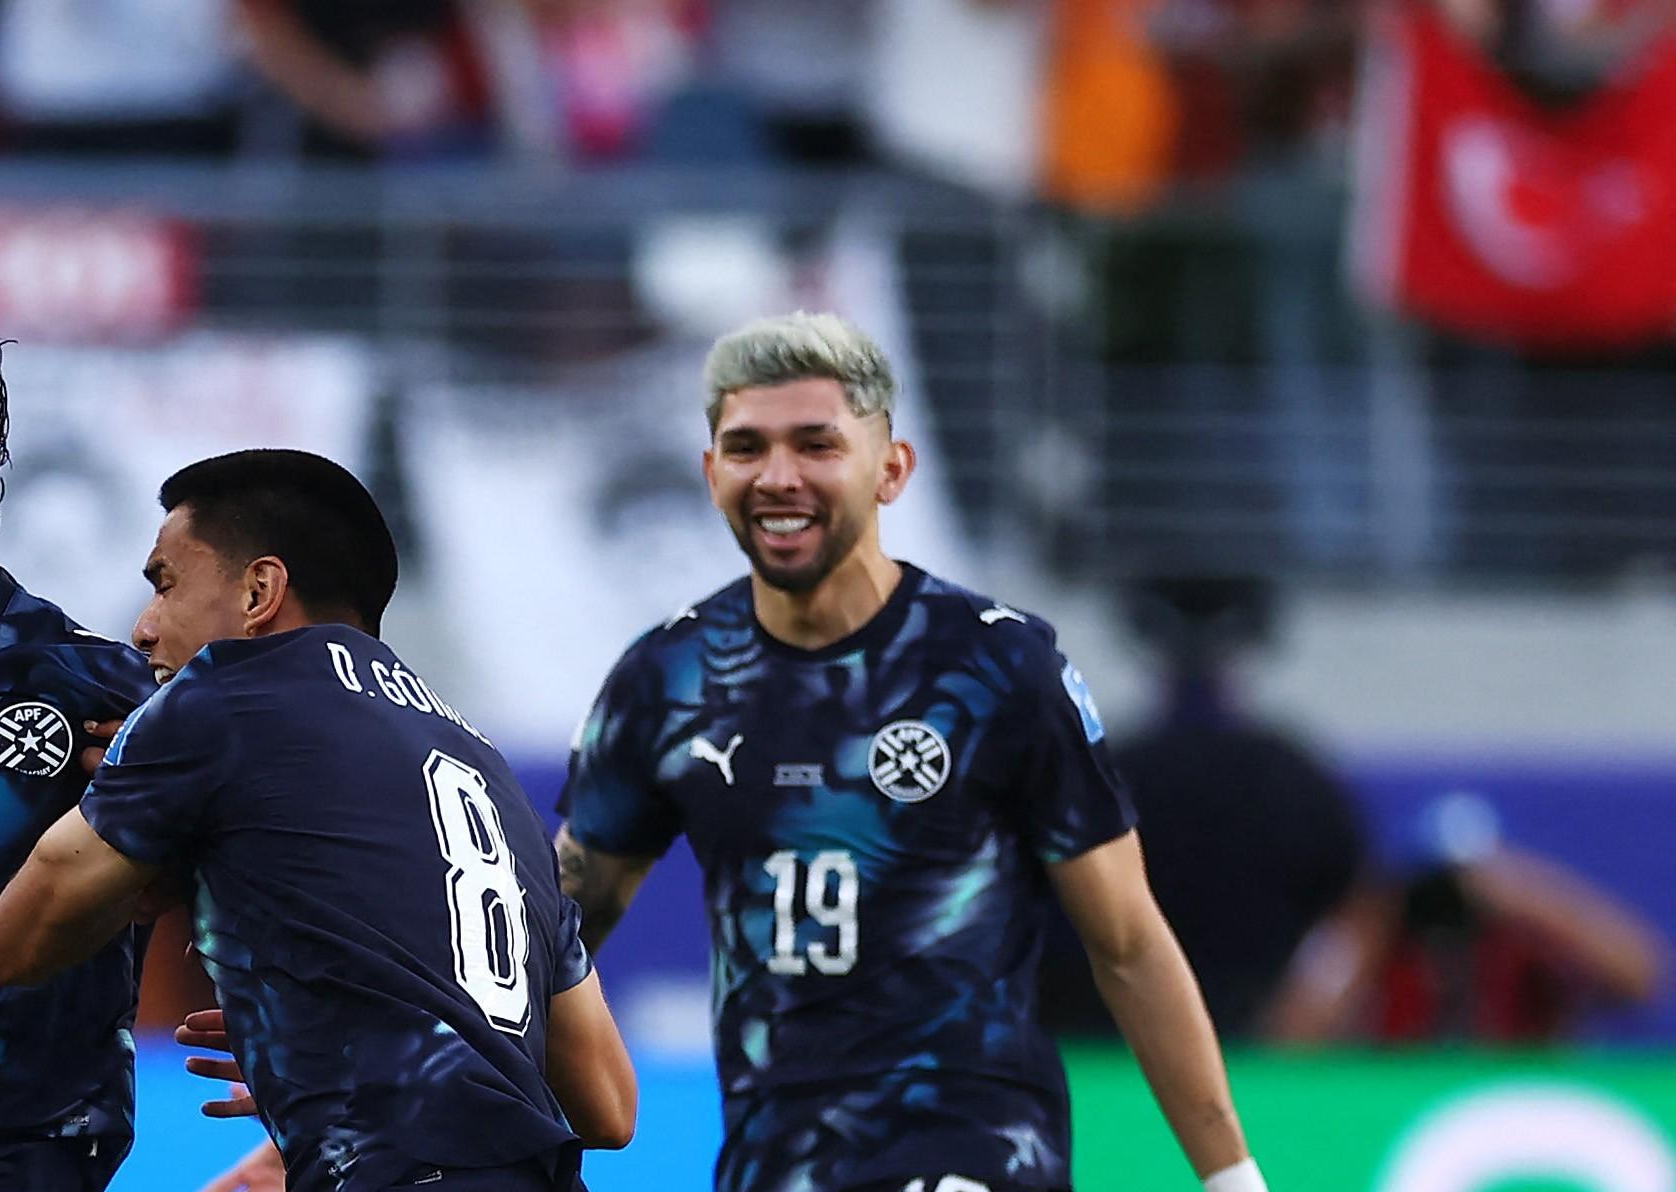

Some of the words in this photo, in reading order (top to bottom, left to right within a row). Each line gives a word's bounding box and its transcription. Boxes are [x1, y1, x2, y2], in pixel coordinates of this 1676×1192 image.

[13, 707, 43, 722] APF
[422, 748, 533, 1038] 8
[763, 850, 860, 976] 19
